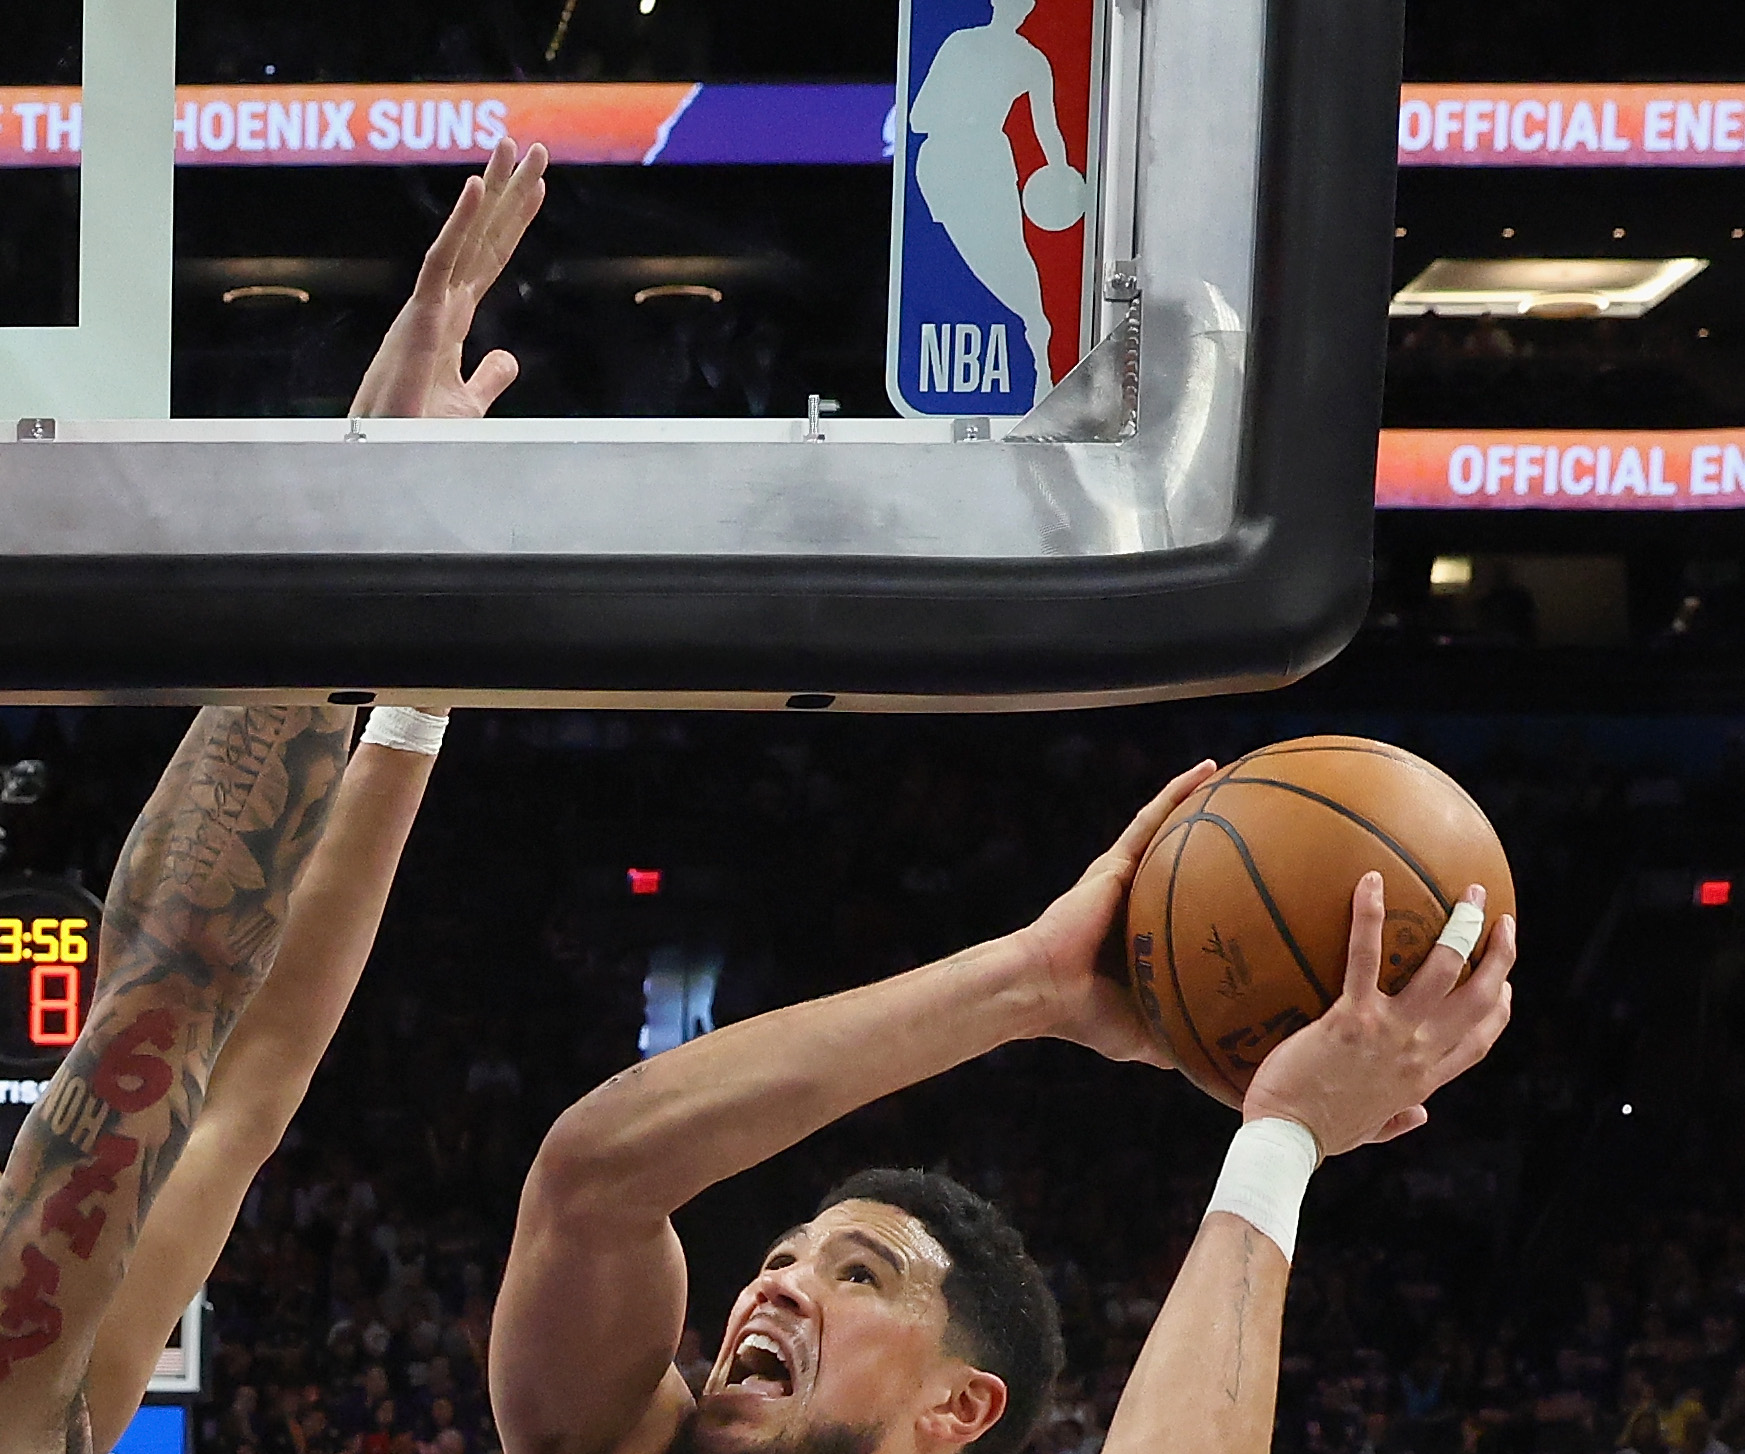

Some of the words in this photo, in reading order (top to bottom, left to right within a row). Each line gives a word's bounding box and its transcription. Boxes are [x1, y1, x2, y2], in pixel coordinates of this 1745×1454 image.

[368, 99, 508, 151] SUNS
[1399, 100, 1631, 152] OFFICIAL
[1643, 100, 1745, 152] ENE
[918, 322, 1011, 393] NBA
[1447, 445, 1678, 496] OFFICIAL
[29, 965, 80, 1046] 8
